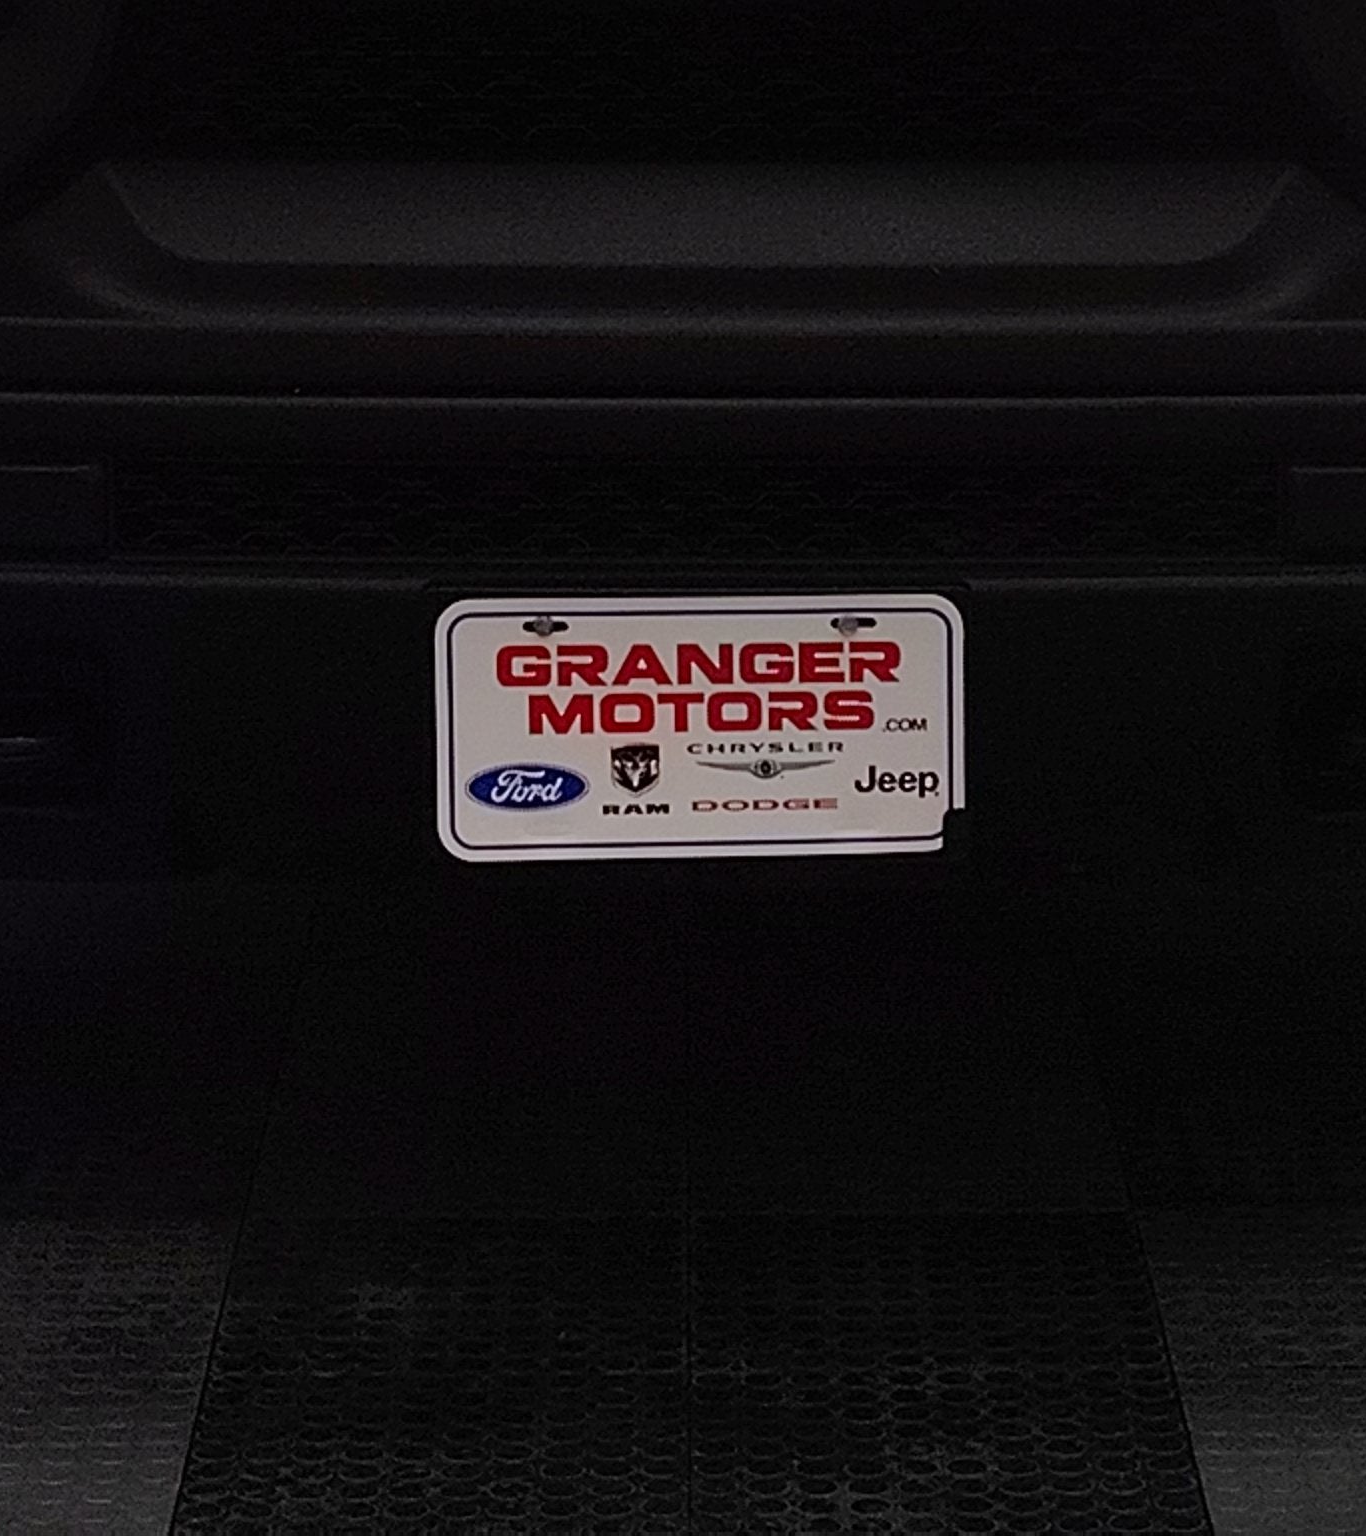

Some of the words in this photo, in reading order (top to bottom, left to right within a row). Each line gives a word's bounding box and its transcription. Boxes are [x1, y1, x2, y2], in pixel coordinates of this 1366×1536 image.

[495, 641, 901, 687] GRANGER
[528, 690, 875, 735] MOTORS
[686, 741, 844, 755] CHRYSLER
[490, 769, 564, 803] Ford
[854, 765, 939, 798] Jeep
[602, 804, 670, 815] RAM
[692, 798, 838, 812] DODGE
